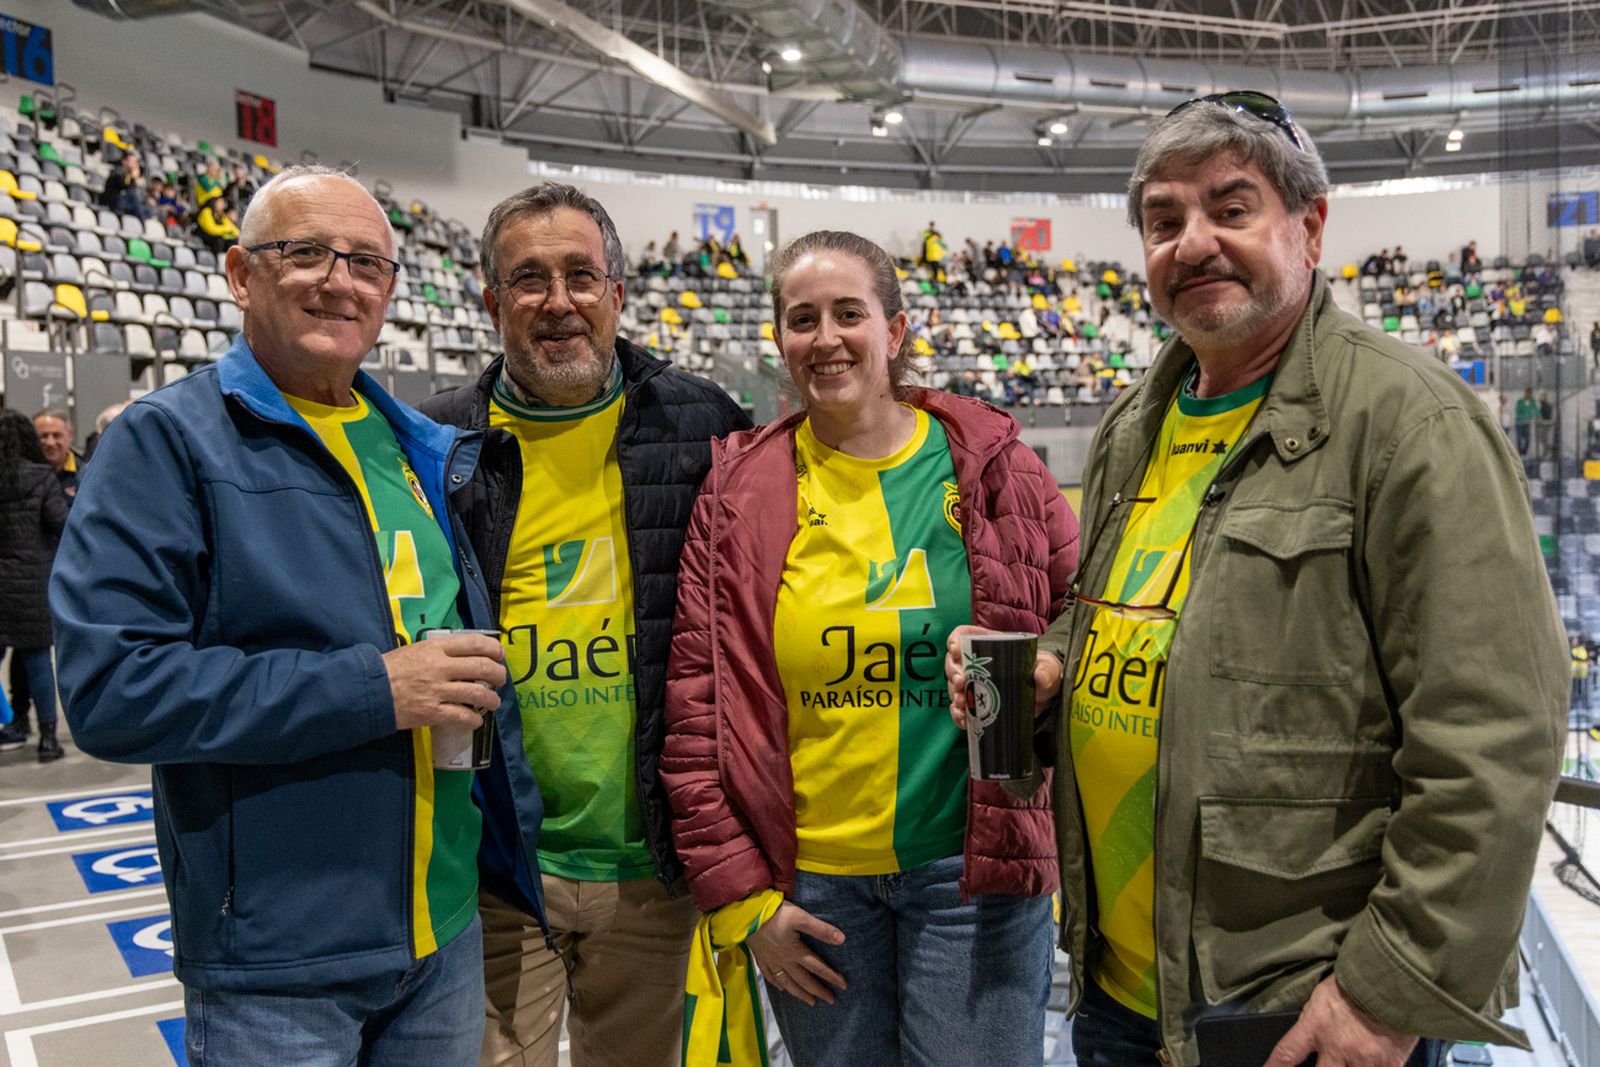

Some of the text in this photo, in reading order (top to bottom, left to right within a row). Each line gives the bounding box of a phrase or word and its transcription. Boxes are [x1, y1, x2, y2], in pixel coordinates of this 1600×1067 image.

[3, 25, 54, 87] 16
[242, 98, 277, 148] 18
[698, 205, 735, 243] 19
[507, 617, 637, 686] Jaé
[821, 623, 949, 686] Jaé
[800, 685, 893, 709] PARAÍSO
